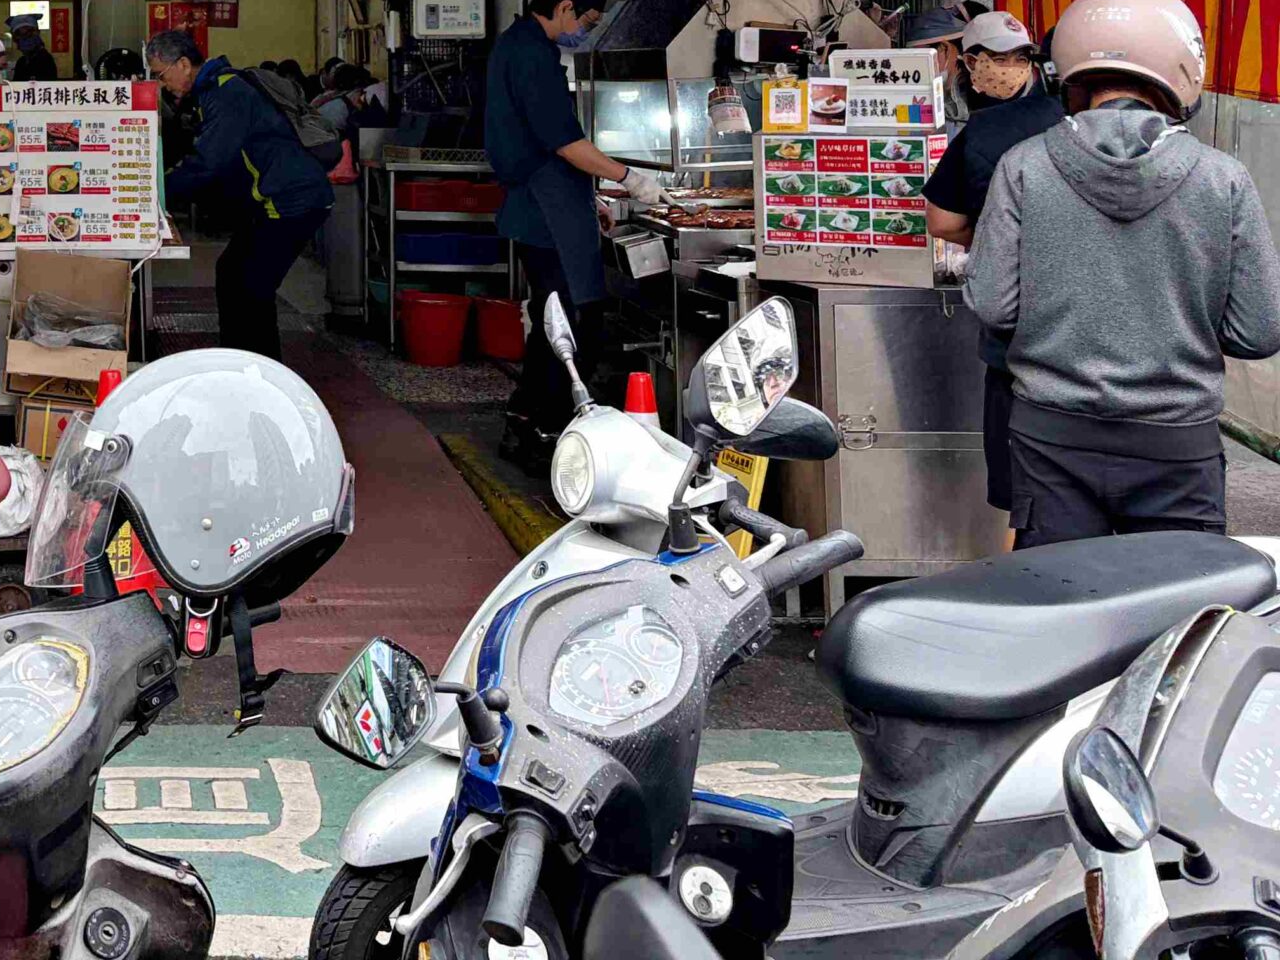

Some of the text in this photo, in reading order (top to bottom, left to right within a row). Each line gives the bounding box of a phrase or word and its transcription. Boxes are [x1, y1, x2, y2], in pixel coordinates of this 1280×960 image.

[5, 86, 131, 106] 內用須排隊取餐
[20, 134, 42, 144] 55元
[84, 134, 107, 144] 40元
[20, 177, 42, 187] 65元
[85, 176, 108, 186] 55元
[86, 224, 108, 234] 65元
[255, 515, 301, 550] Headgear
[233, 550, 252, 565] Moto
